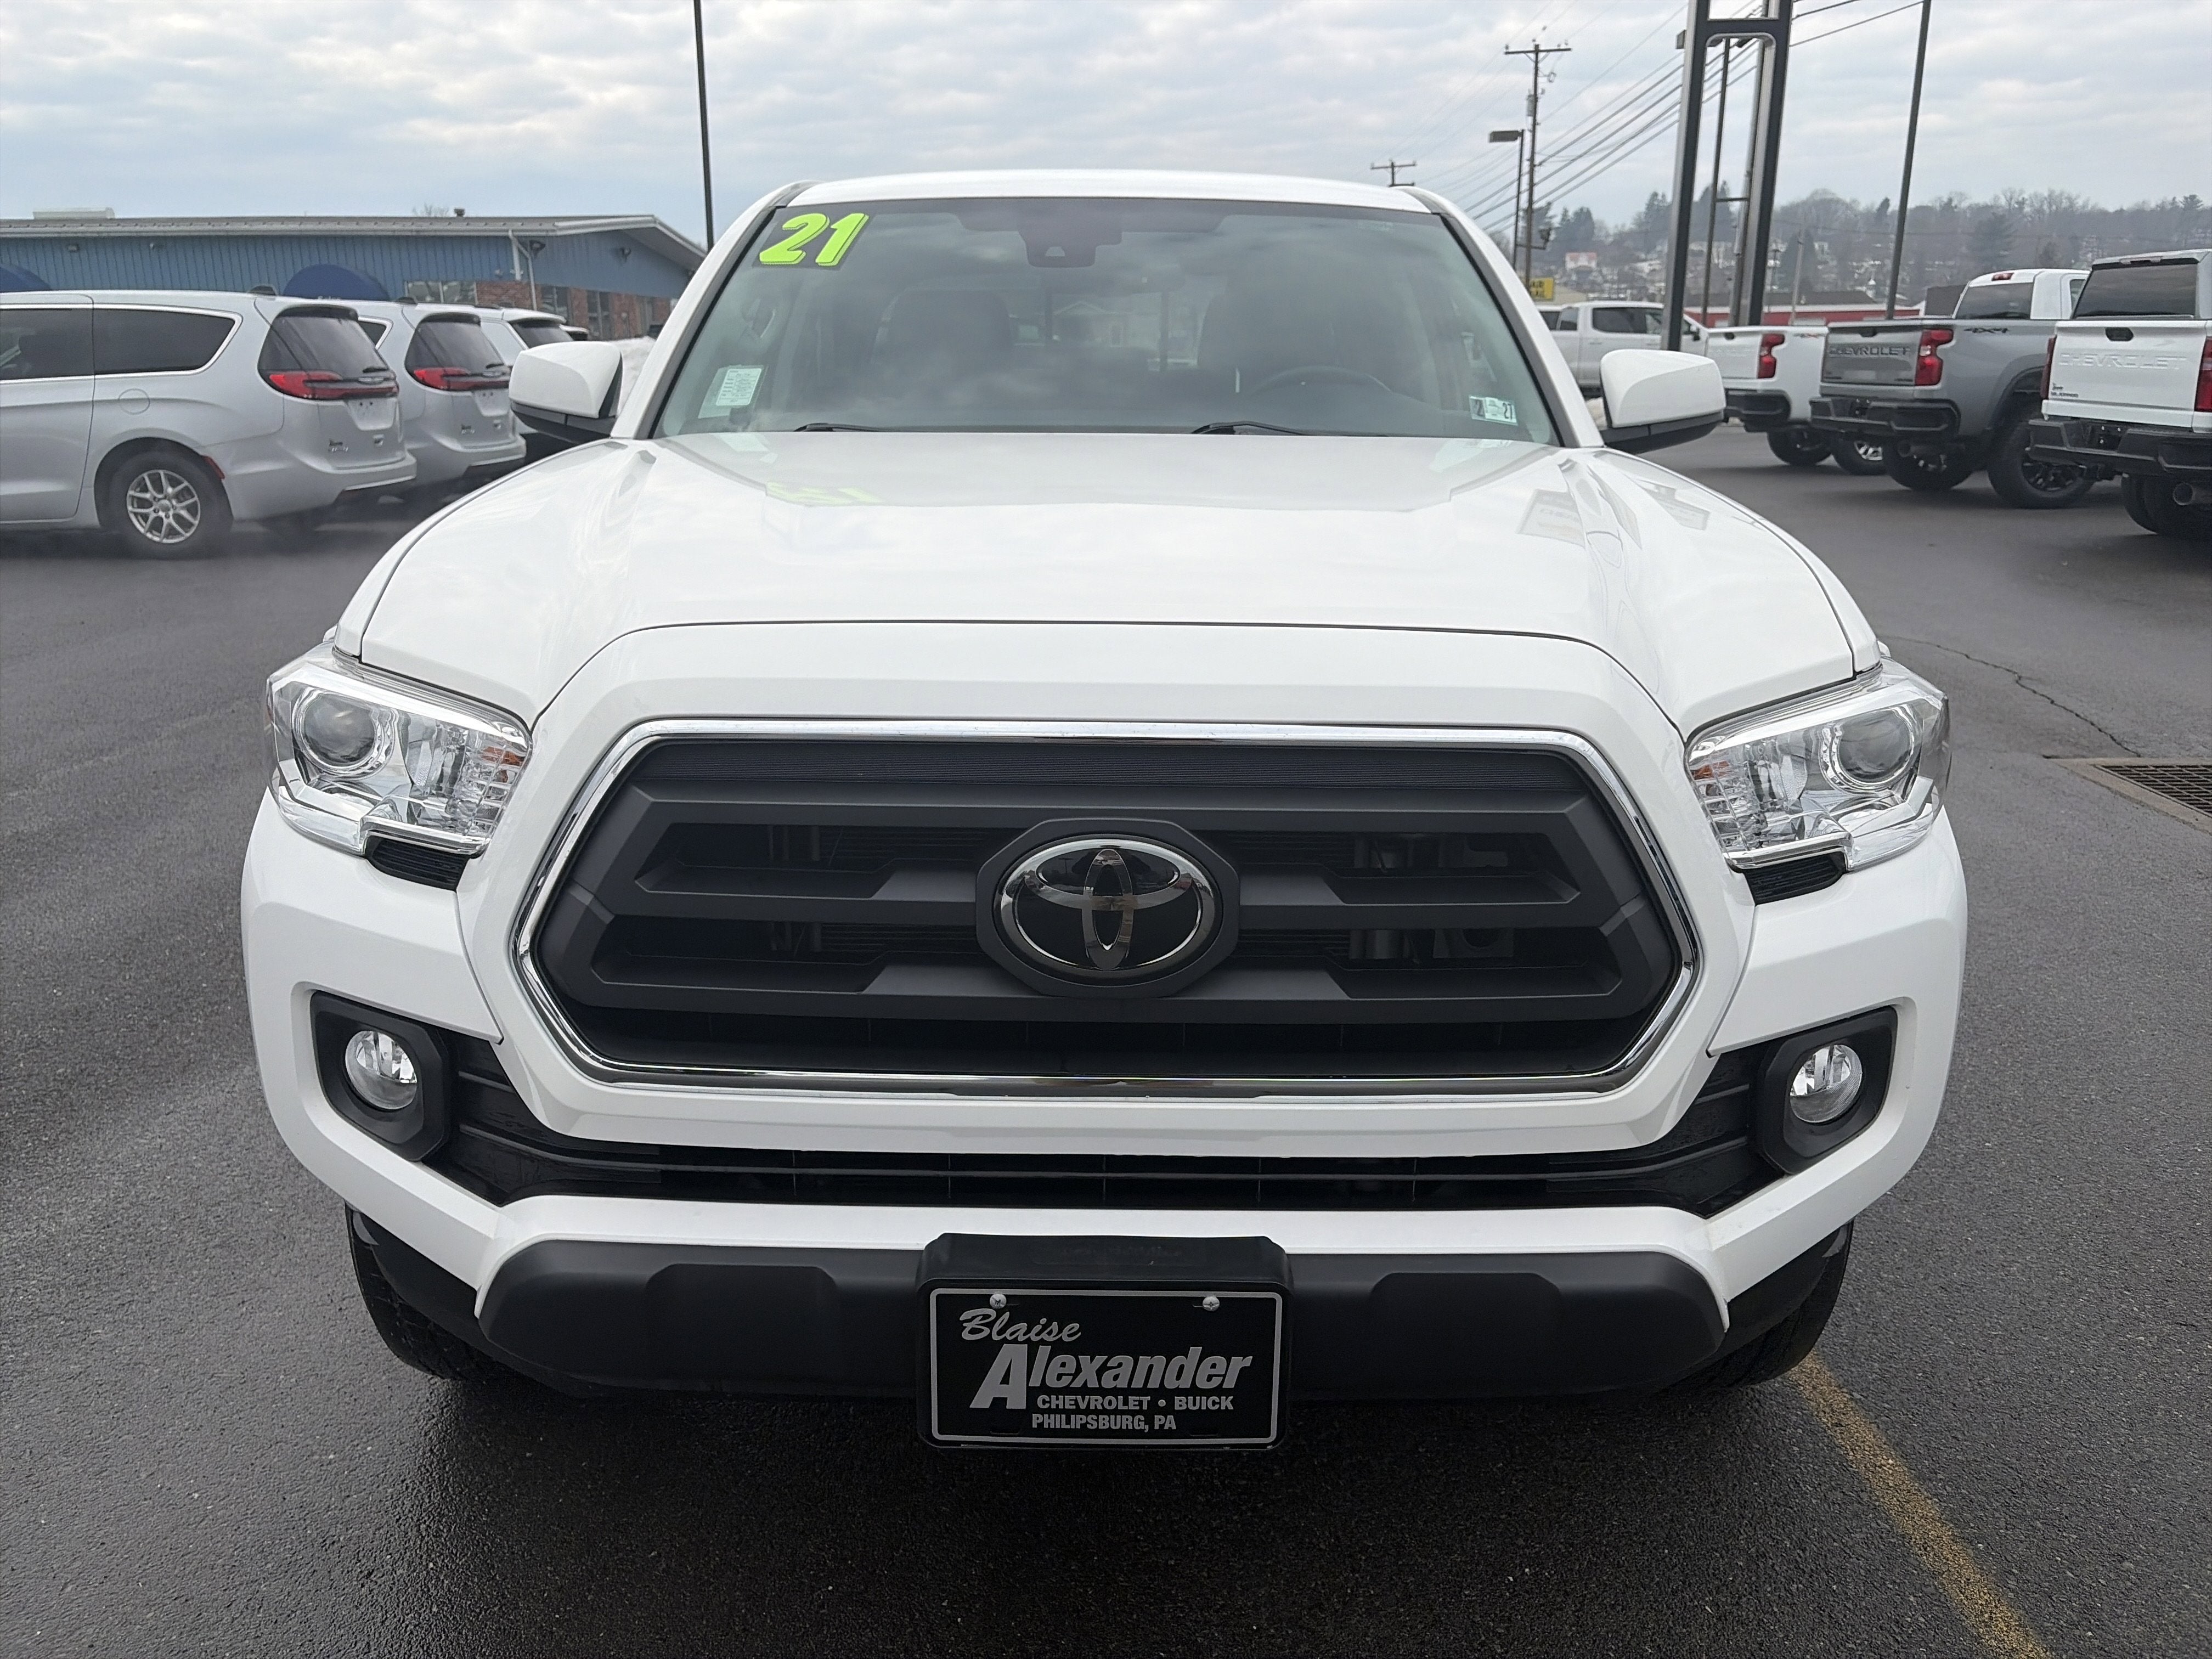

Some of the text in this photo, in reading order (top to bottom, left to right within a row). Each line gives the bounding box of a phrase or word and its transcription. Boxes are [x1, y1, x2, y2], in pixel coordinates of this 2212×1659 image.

[759, 213, 869, 266] 21
[2059, 353, 2187, 370] CHEVROLET
[960, 1308, 1081, 1342] Blaise
[969, 1344, 1253, 1410] Alexander
[1037, 1395, 1234, 1411] CHEVROLET BUICK
[1032, 1414, 1177, 1433] PHILIPSBURG, PA
